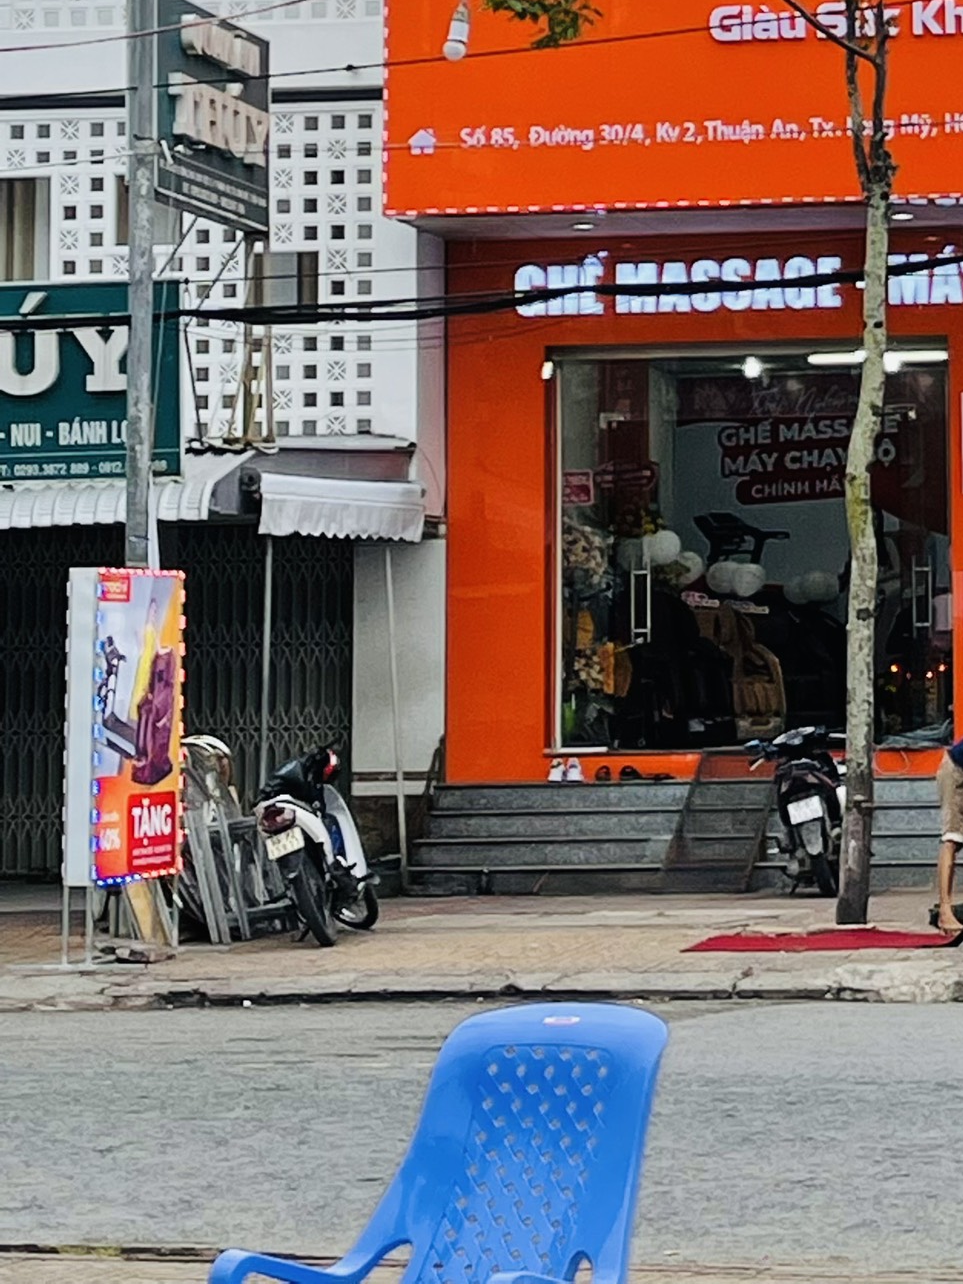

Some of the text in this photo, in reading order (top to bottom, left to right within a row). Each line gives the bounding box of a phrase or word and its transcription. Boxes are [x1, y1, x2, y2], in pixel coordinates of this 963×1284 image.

[709, 3, 807, 42] Giàu
[615, 256, 842, 314] MASSAGE
[10, 423, 42, 447] NUI
[58, 416, 108, 446] BÁNH
